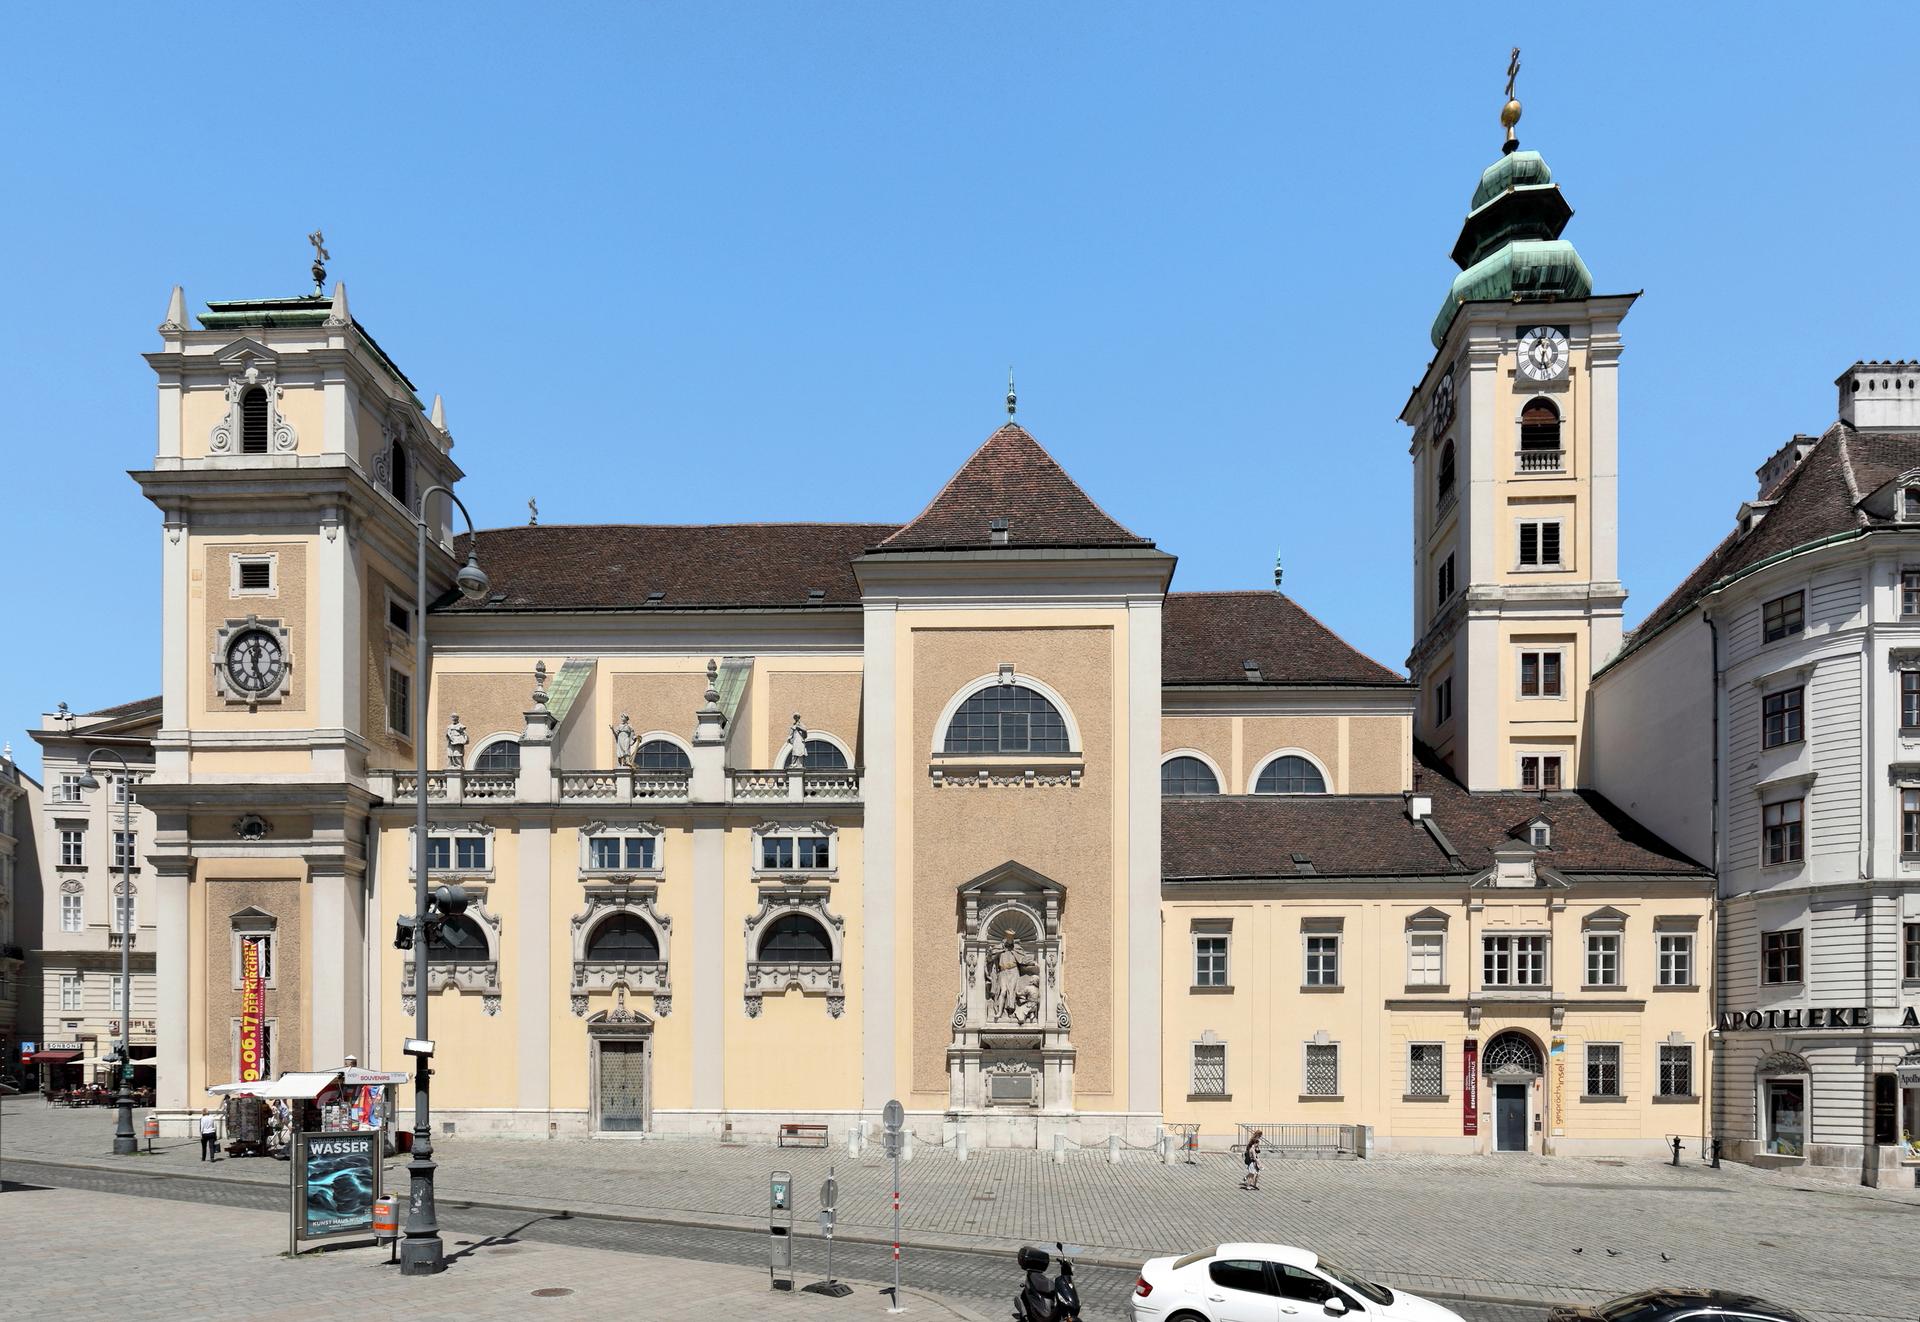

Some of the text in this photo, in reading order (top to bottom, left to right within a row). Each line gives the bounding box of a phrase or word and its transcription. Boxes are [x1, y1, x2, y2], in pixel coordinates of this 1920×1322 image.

[249, 993, 259, 1013] DER
[1718, 1007, 1870, 1031] APOTHEKE
[310, 1141, 369, 1155] WASSER
